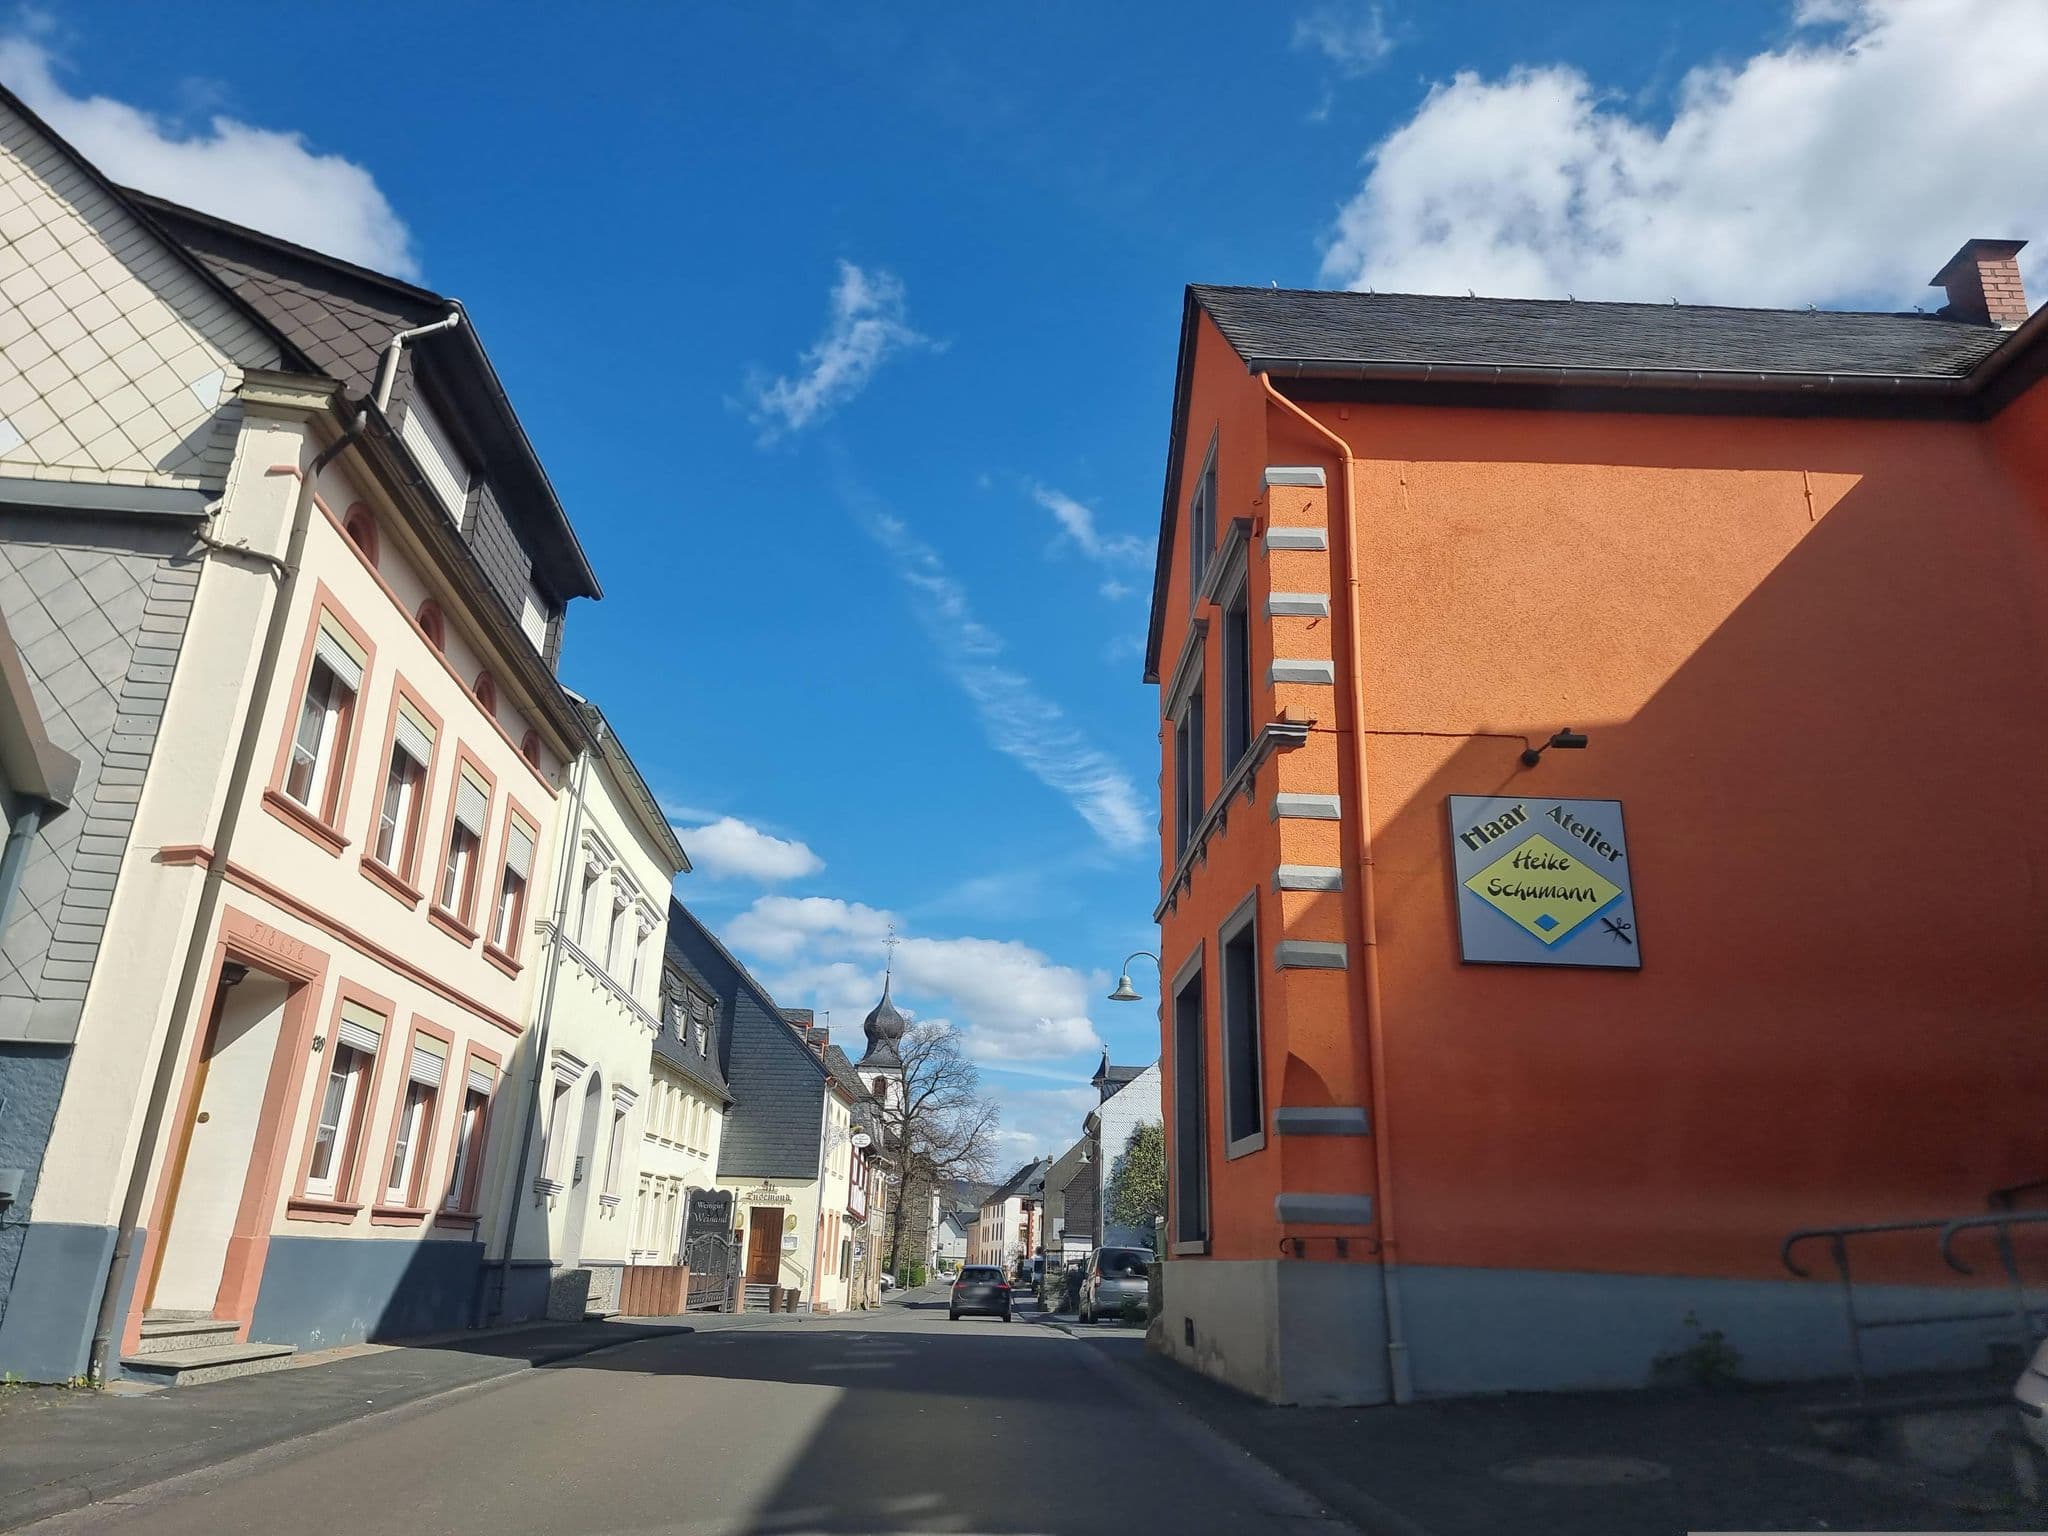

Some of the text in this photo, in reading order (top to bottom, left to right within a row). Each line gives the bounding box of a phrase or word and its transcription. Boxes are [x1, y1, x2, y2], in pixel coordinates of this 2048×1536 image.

[1460, 804, 1624, 863] Haar Atelier
[1512, 850, 1571, 871] Heike
[1487, 878, 1597, 902] Schumann
[697, 1201, 724, 1211] Weingut
